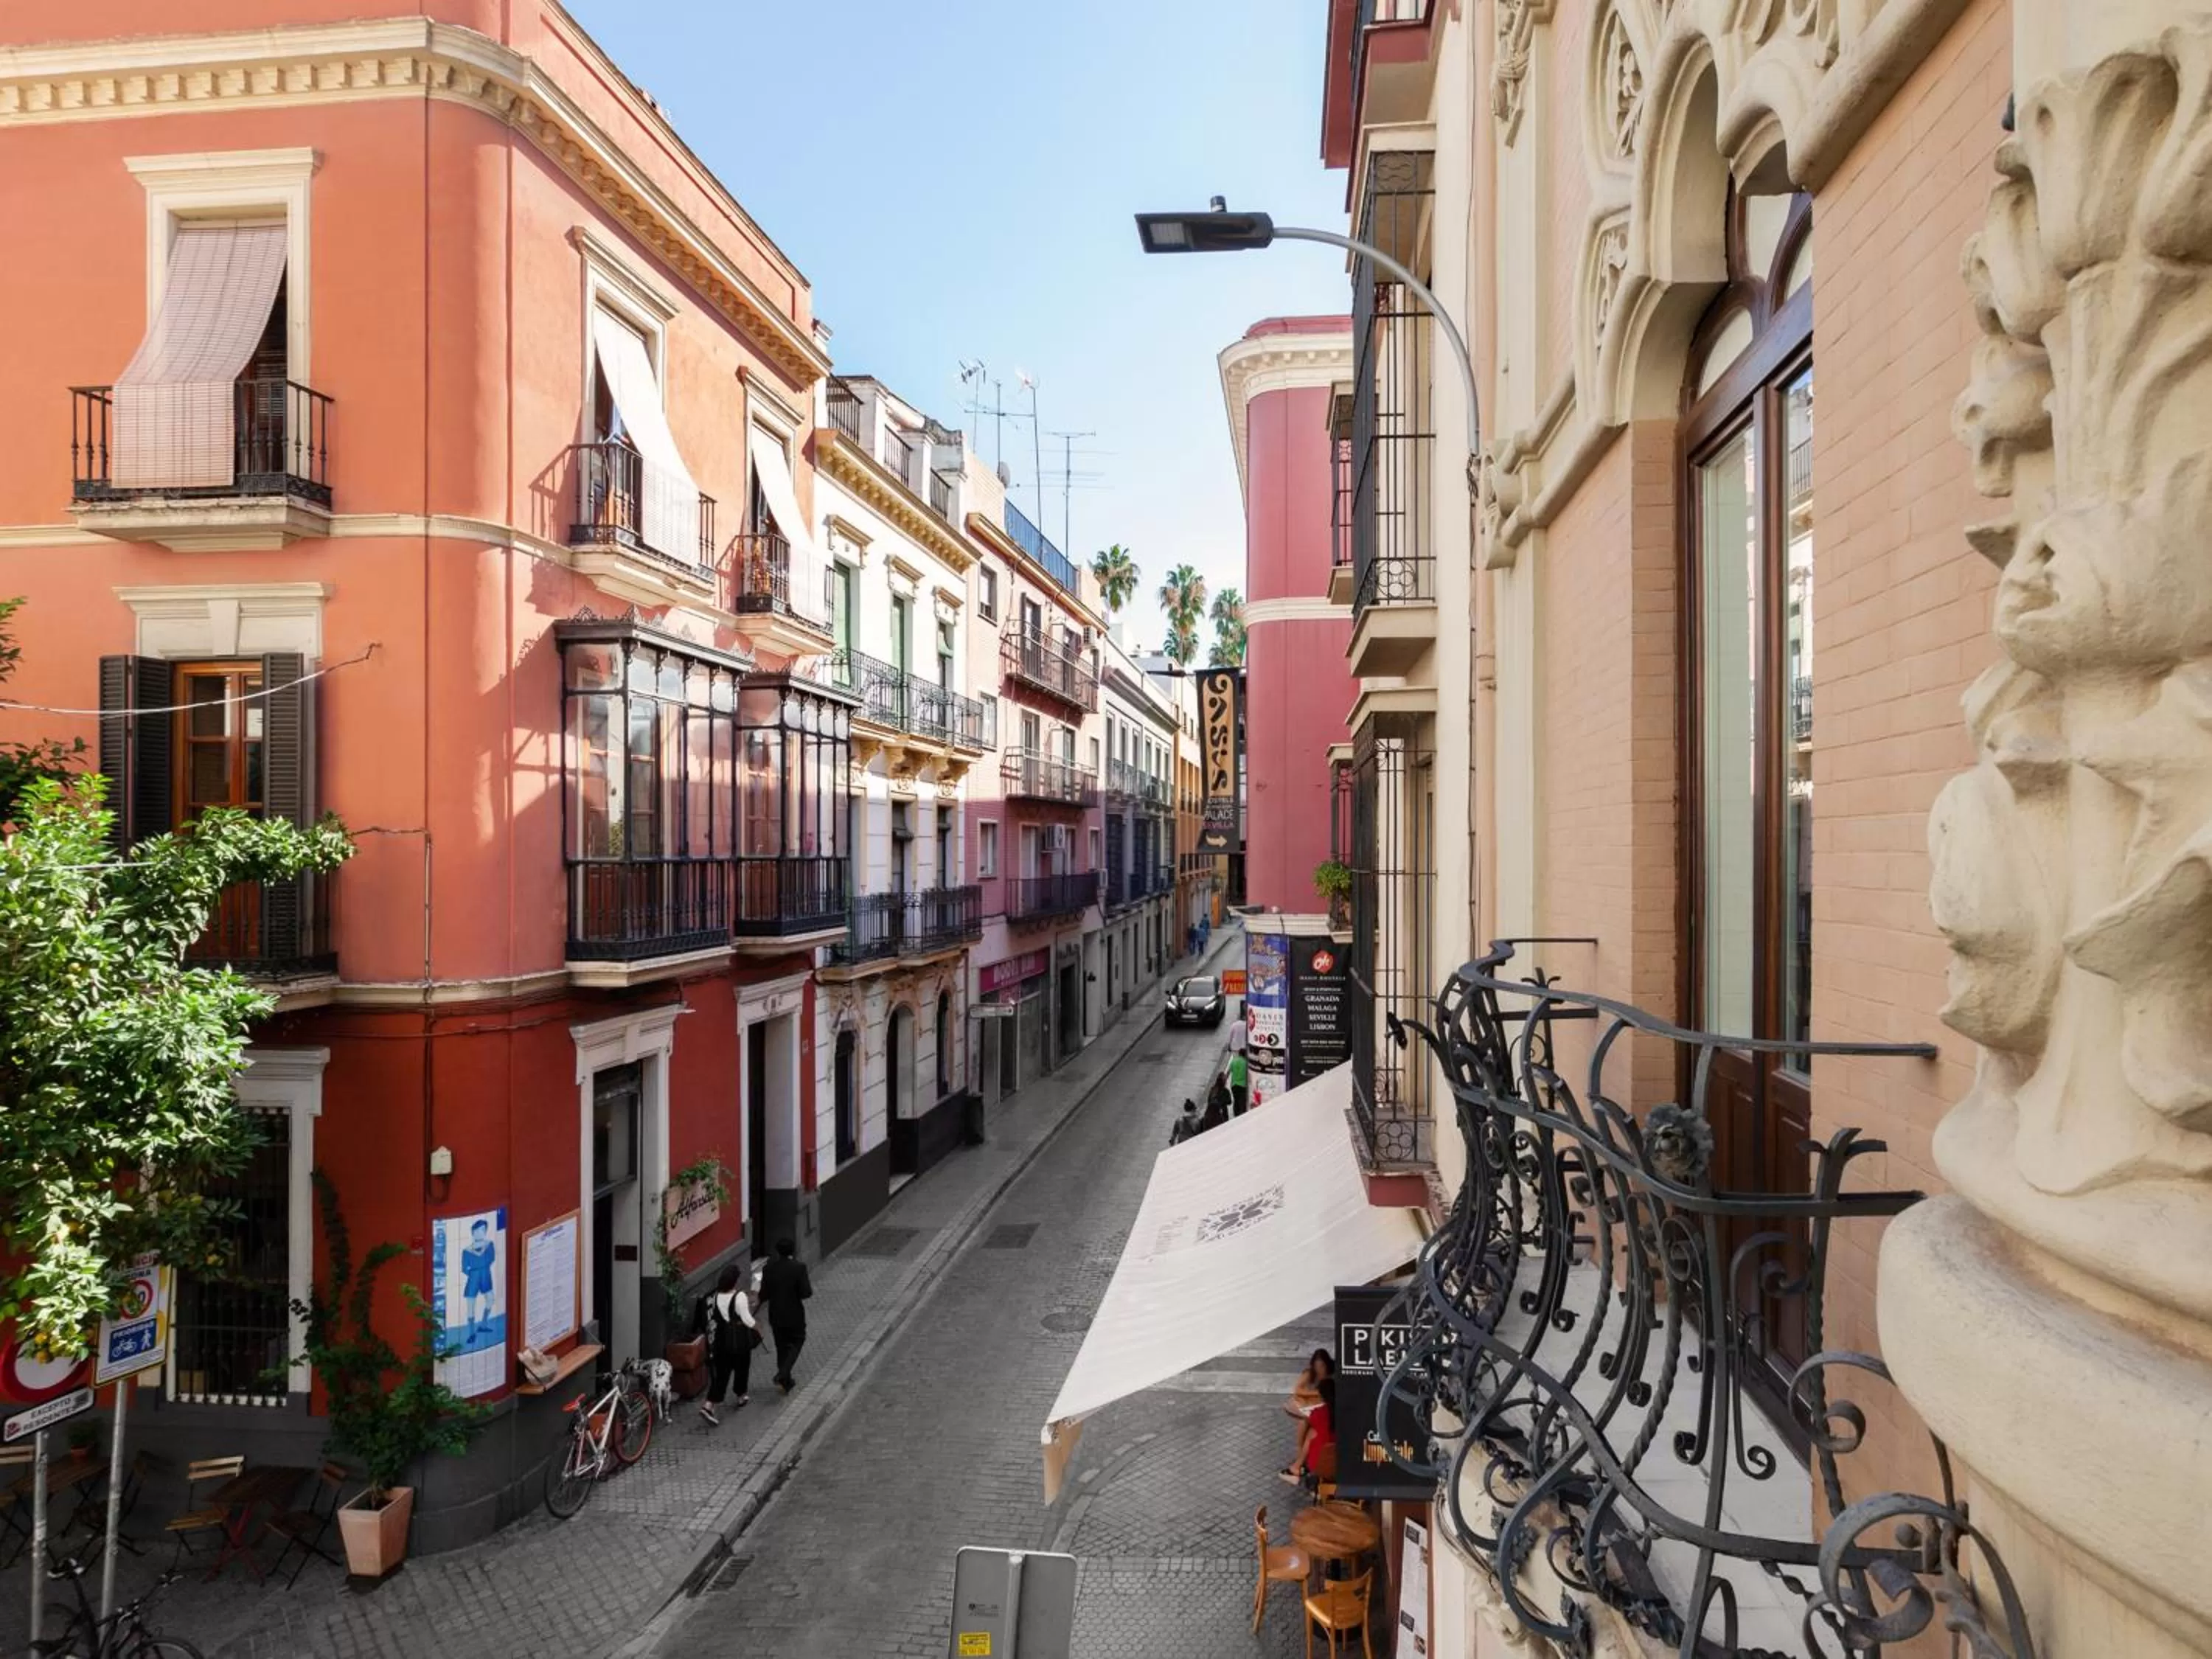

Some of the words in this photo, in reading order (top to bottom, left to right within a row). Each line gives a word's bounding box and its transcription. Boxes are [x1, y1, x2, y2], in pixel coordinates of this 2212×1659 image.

[1354, 1329, 1417, 1346] PKI
[23, 1406, 77, 1431] RESIDENTES
[30, 1397, 72, 1418] EXCEPTO
[1363, 1439, 1413, 1468] Impeiale
